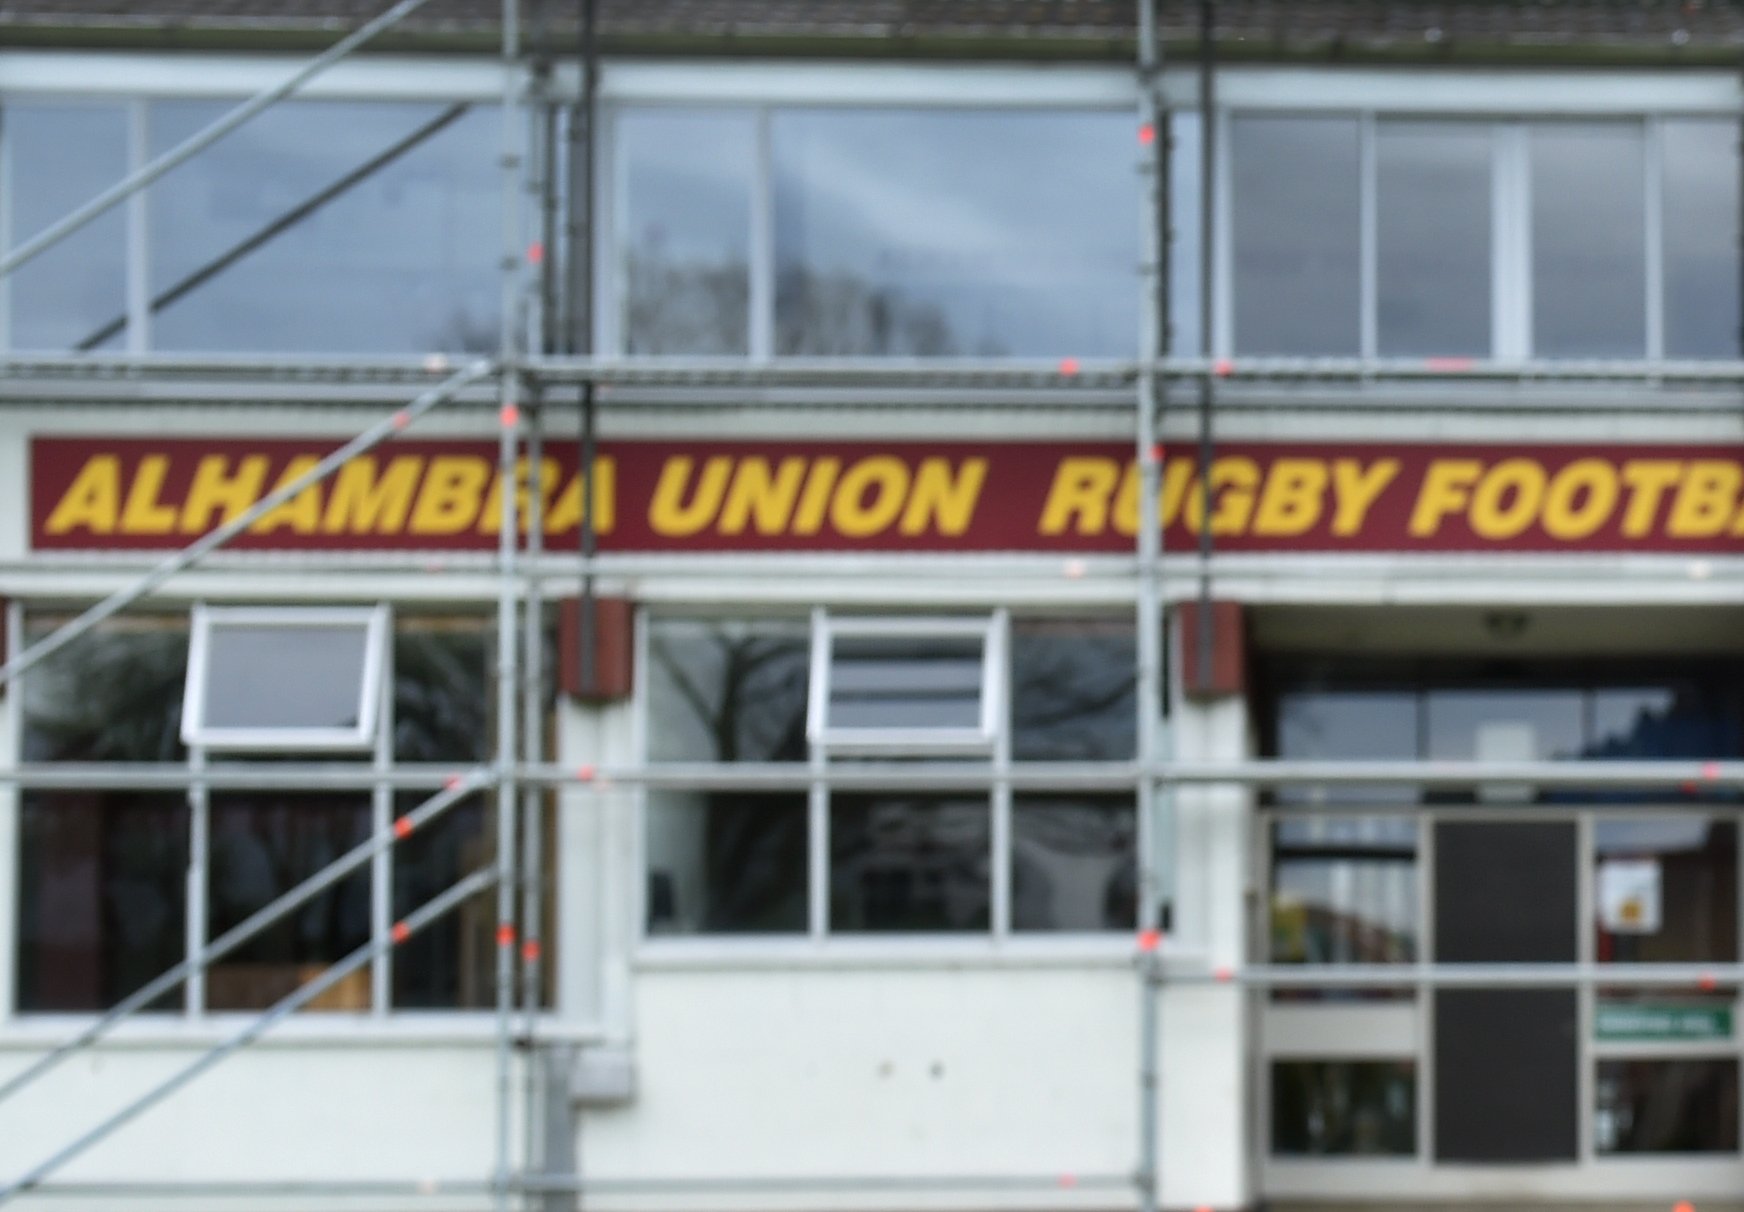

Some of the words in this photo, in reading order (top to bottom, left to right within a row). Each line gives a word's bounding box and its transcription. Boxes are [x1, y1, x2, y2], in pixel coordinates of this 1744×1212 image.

[44, 454, 615, 535] ALHAMBRA
[648, 457, 987, 536] UNION
[1037, 457, 1400, 536] RUGBY
